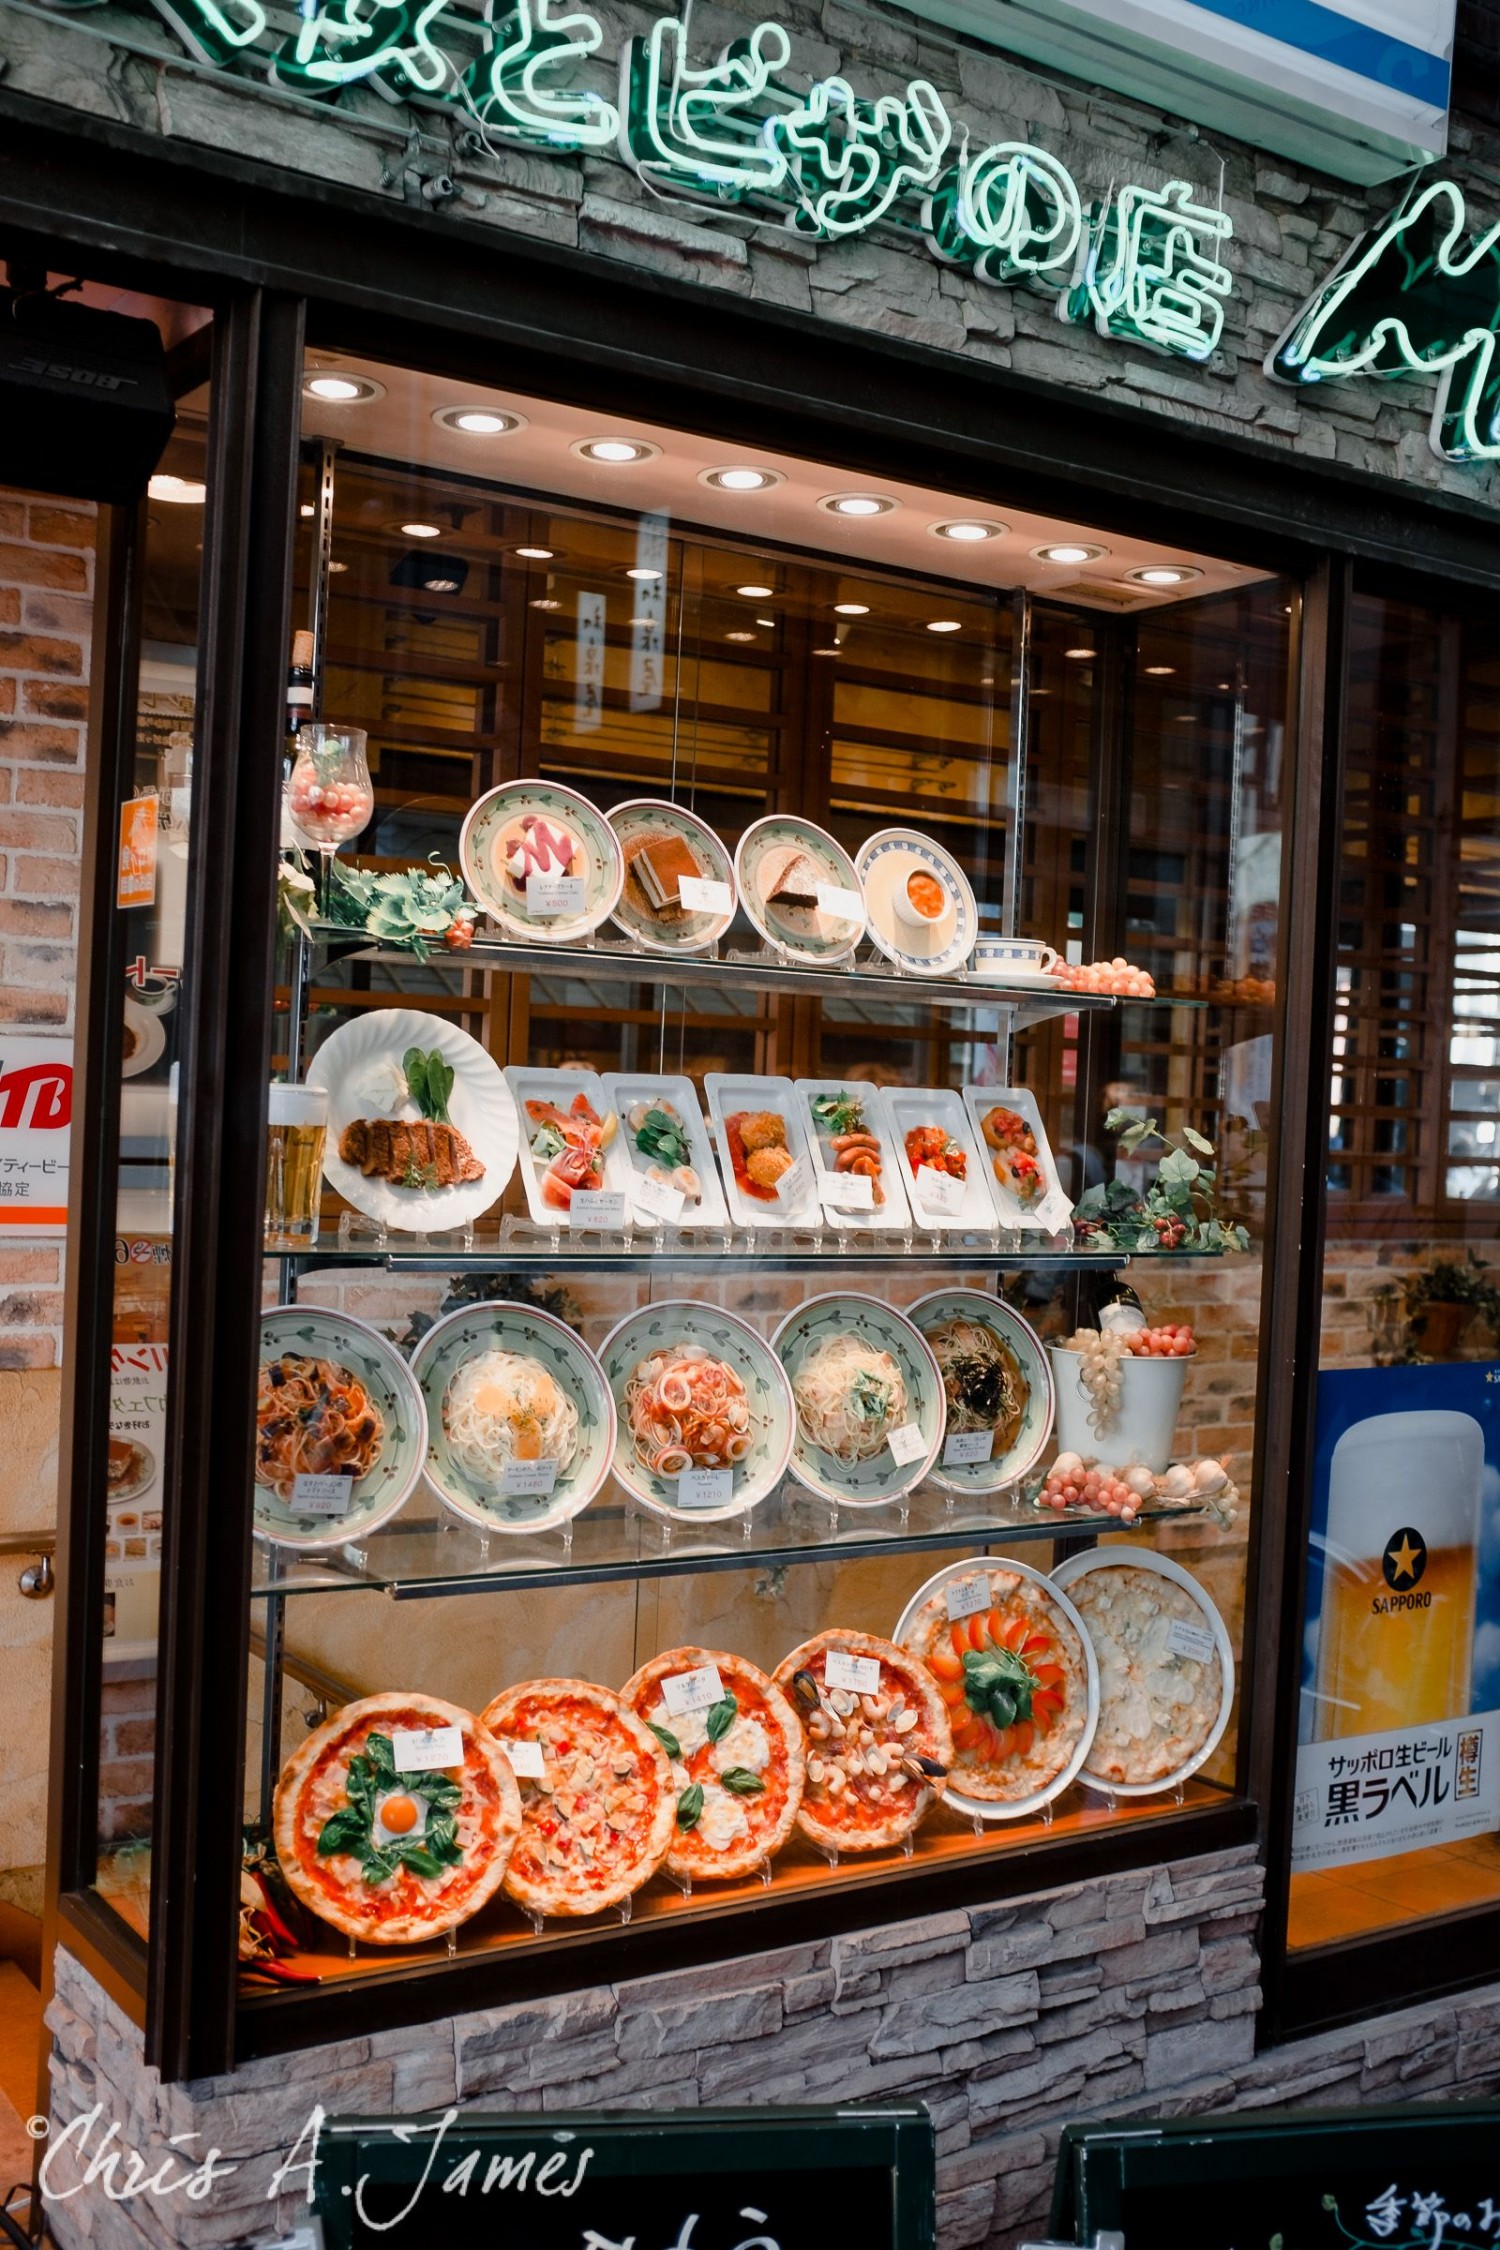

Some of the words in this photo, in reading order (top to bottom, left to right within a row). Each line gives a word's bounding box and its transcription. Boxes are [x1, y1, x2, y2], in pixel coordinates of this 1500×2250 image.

[0, 1060, 73, 1129] TB
[0, 1158, 69, 1174] ティービー
[1371, 1591, 1432, 1615] SAPPORO
[1329, 1736, 1453, 1779] サッポロ生ビール
[1458, 1734, 1480, 1796] 樽生
[1324, 1765, 1450, 1828] 黒ラベル
